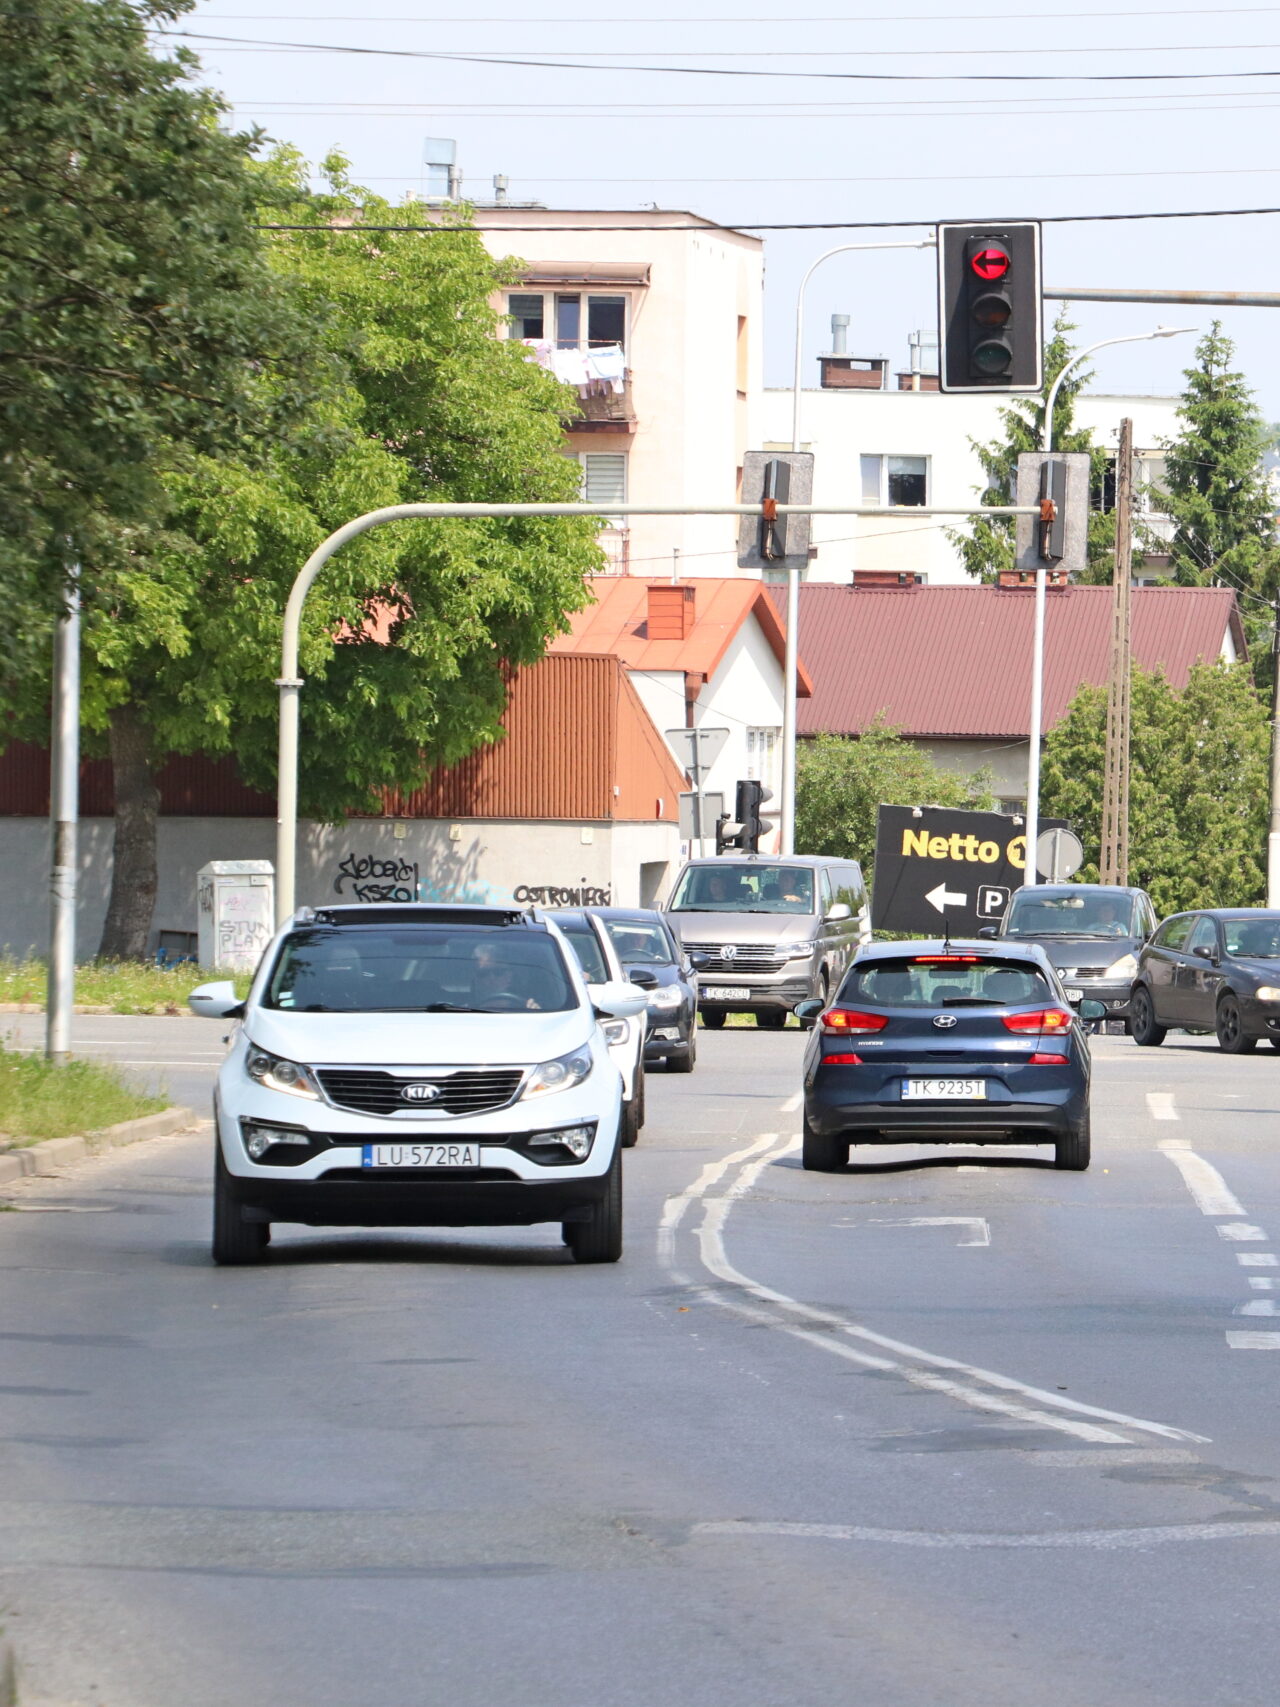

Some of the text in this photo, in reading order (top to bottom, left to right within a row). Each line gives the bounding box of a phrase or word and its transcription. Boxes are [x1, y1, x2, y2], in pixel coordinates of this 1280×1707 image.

[902, 829, 1000, 864] Netto
[985, 891, 1003, 913] P
[221, 934, 265, 948] PLAY
[406, 1087, 434, 1099] KIA
[912, 1080, 983, 1095] TK 9235T
[377, 1146, 473, 1165] LU 572RA
